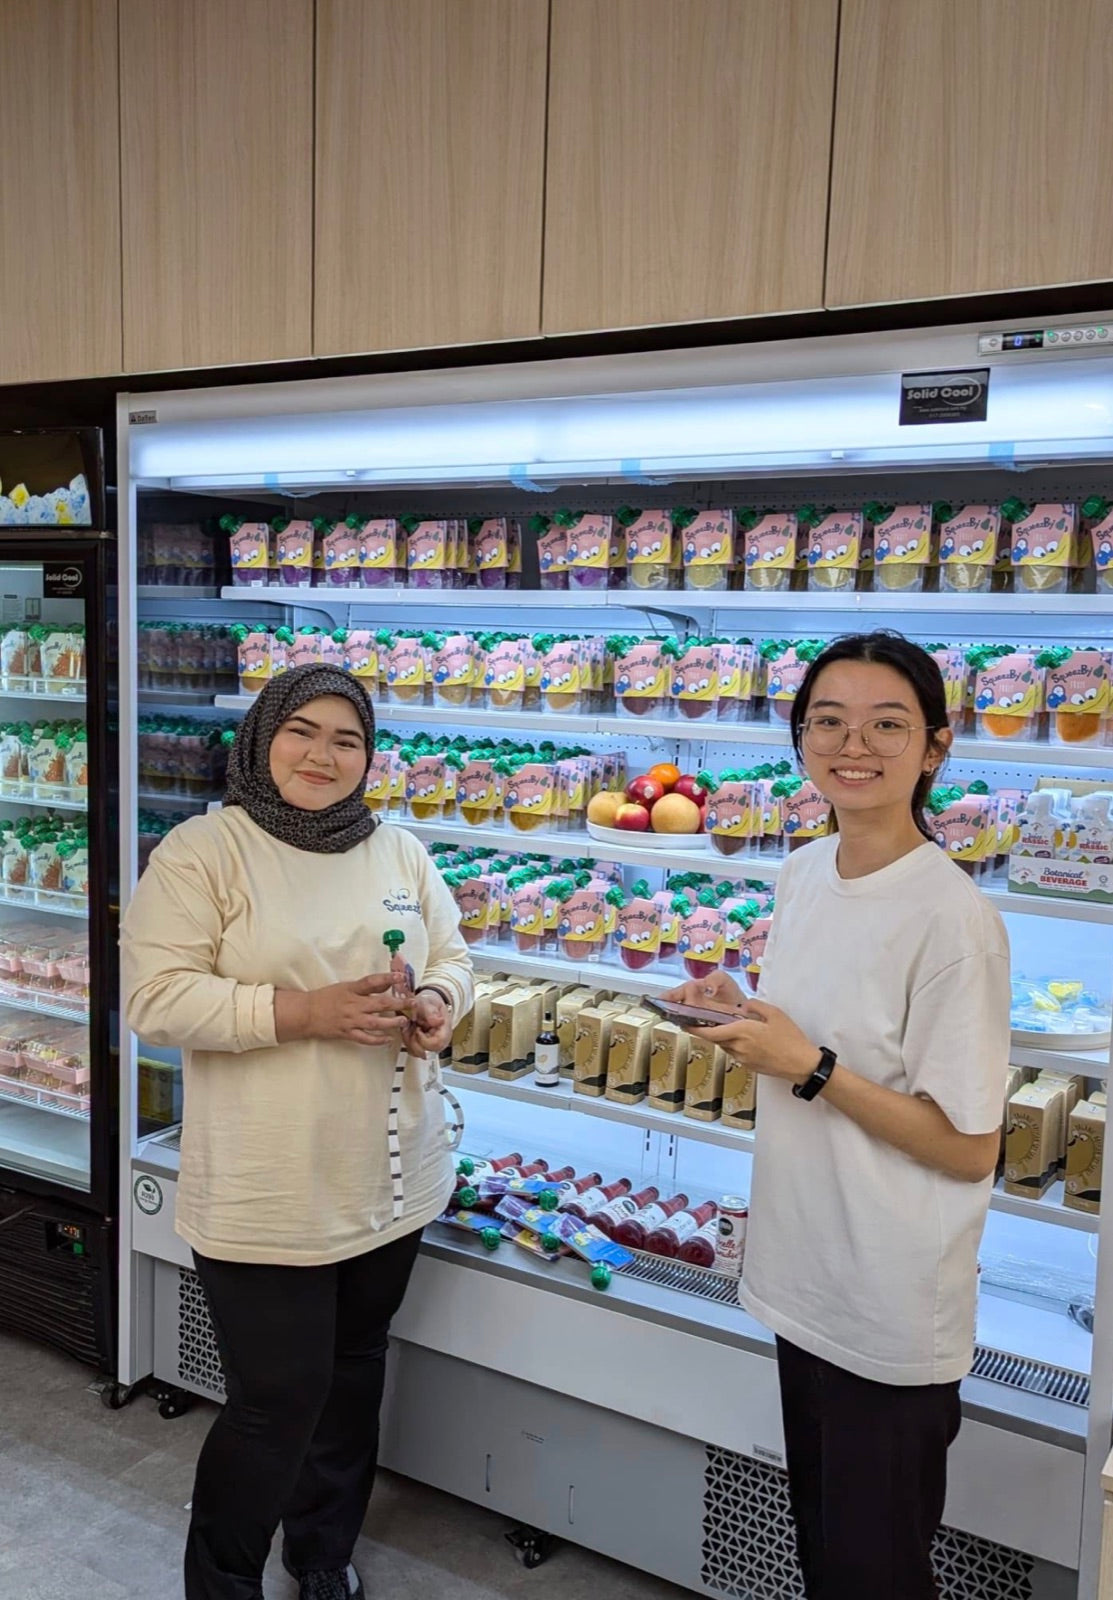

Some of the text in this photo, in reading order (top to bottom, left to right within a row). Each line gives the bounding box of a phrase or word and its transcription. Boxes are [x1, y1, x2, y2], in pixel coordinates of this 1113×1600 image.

[907, 386, 974, 400] Solid Cool
[878, 517, 914, 537] SqueezBy
[944, 517, 980, 536] SqueezBy
[1015, 517, 1056, 538] SqueezBy
[981, 669, 1021, 686] SqueezBy
[1051, 664, 1093, 684] SqueezBy
[786, 792, 822, 811] SqueezBy
[933, 813, 971, 830] SqueezBy
[1040, 876, 1088, 887] BEVERAGE
[1043, 867, 1085, 879] Botanical
